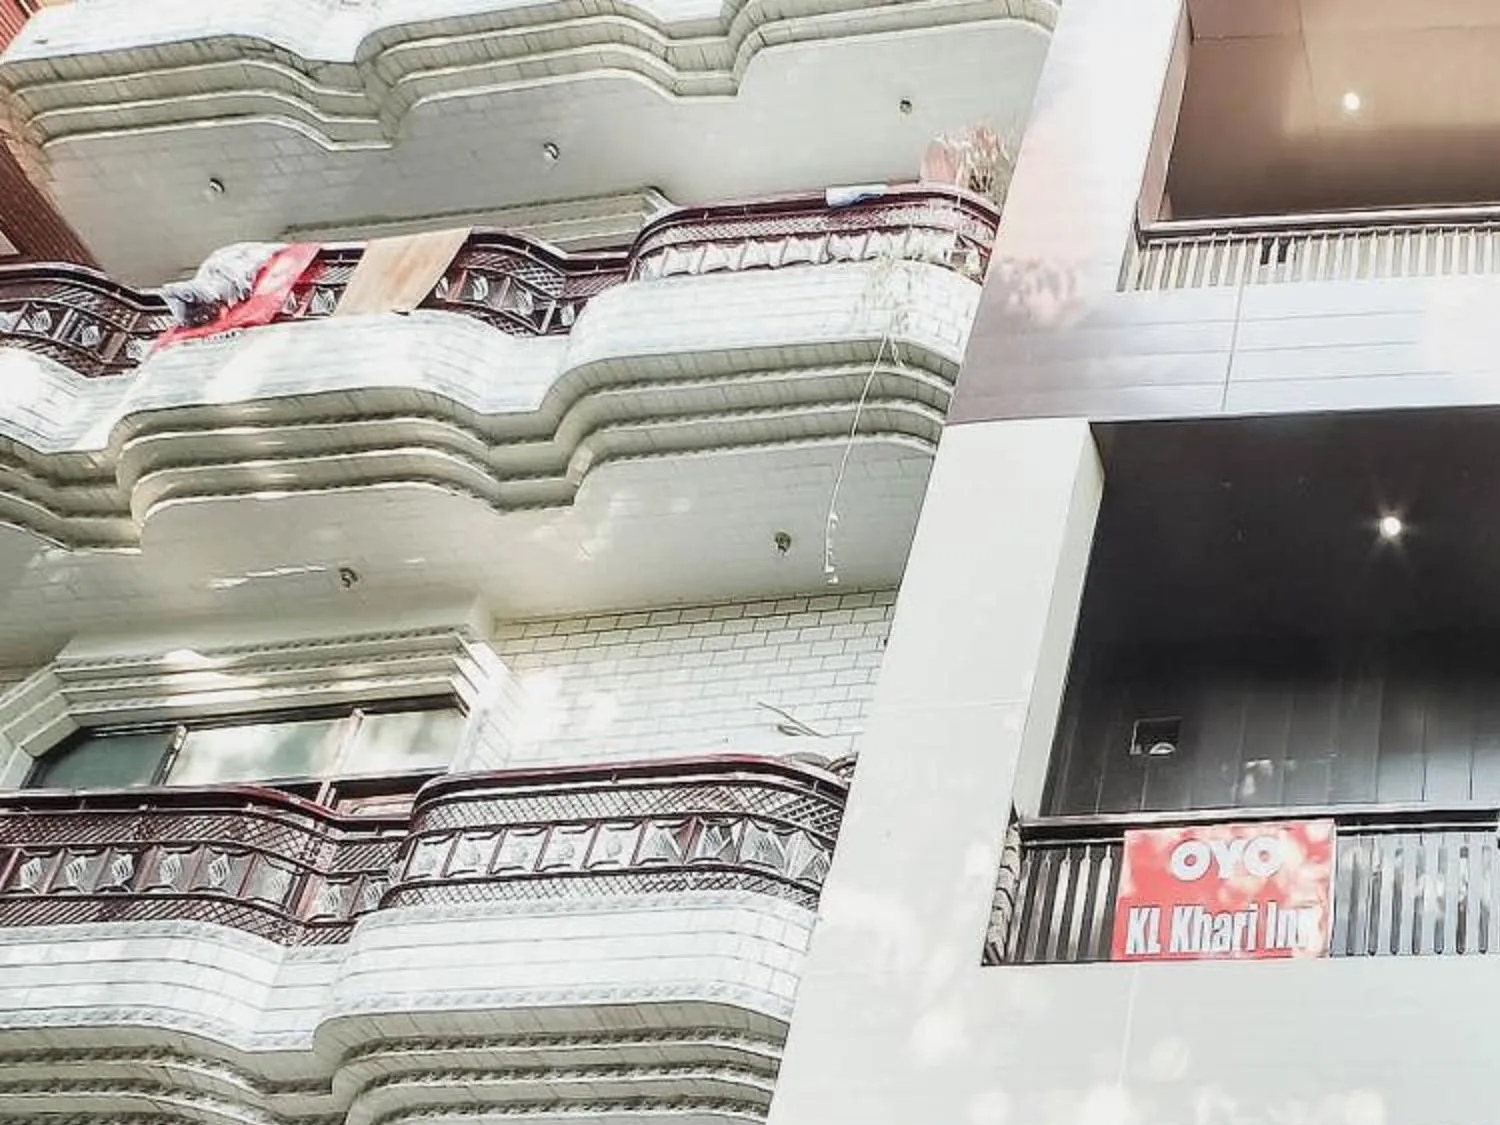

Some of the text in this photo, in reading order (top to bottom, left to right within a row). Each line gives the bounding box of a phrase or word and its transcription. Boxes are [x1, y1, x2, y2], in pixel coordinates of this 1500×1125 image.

[1170, 835, 1284, 881] OYO
[1126, 906, 1161, 955] KL
[1169, 902, 1259, 953] Khari
